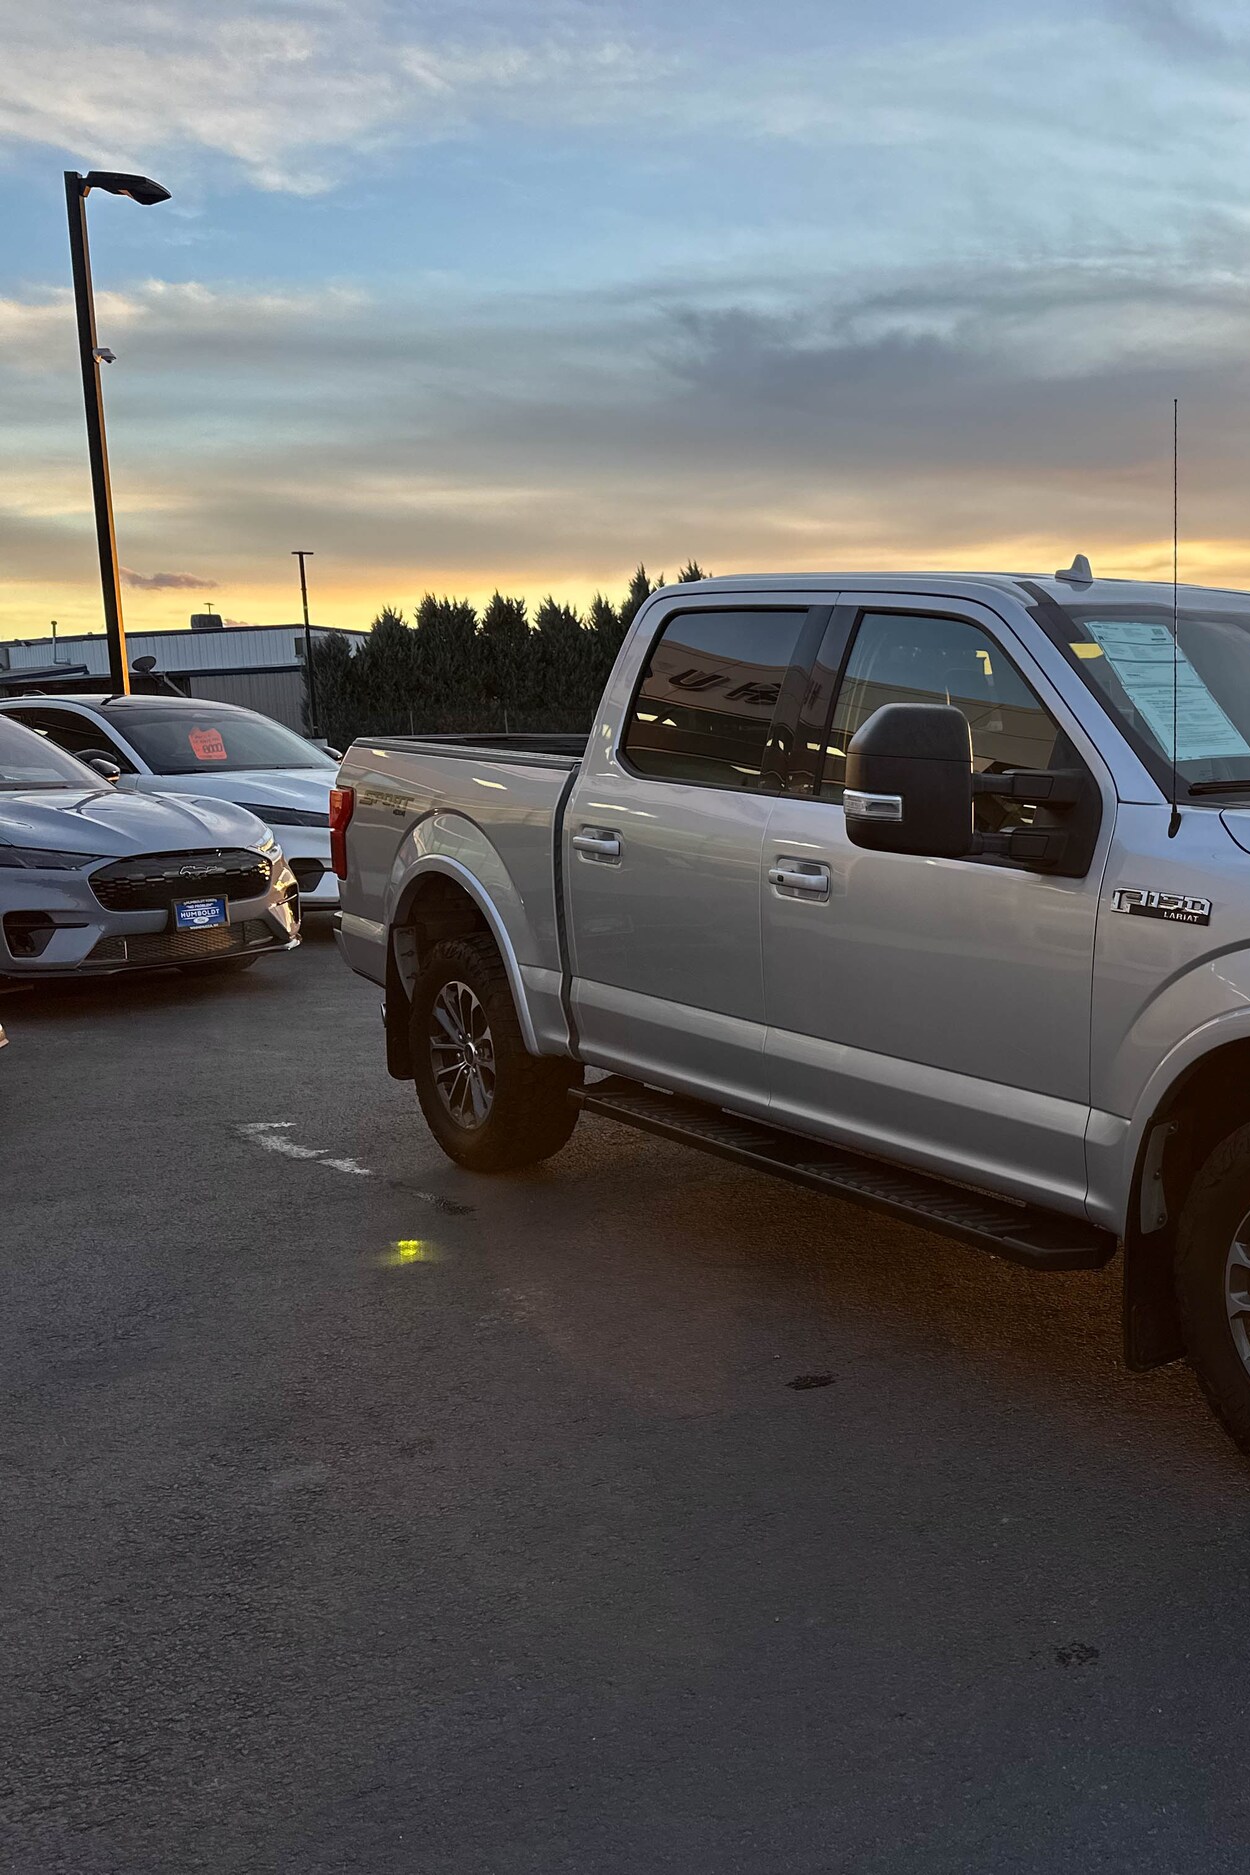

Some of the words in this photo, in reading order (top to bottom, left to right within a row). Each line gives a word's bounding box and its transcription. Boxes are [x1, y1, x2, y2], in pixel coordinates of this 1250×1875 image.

[359, 790, 415, 809] SPORT
[180, 909, 220, 918] HUMBOLDT
[1163, 911, 1200, 923] LARIAT
